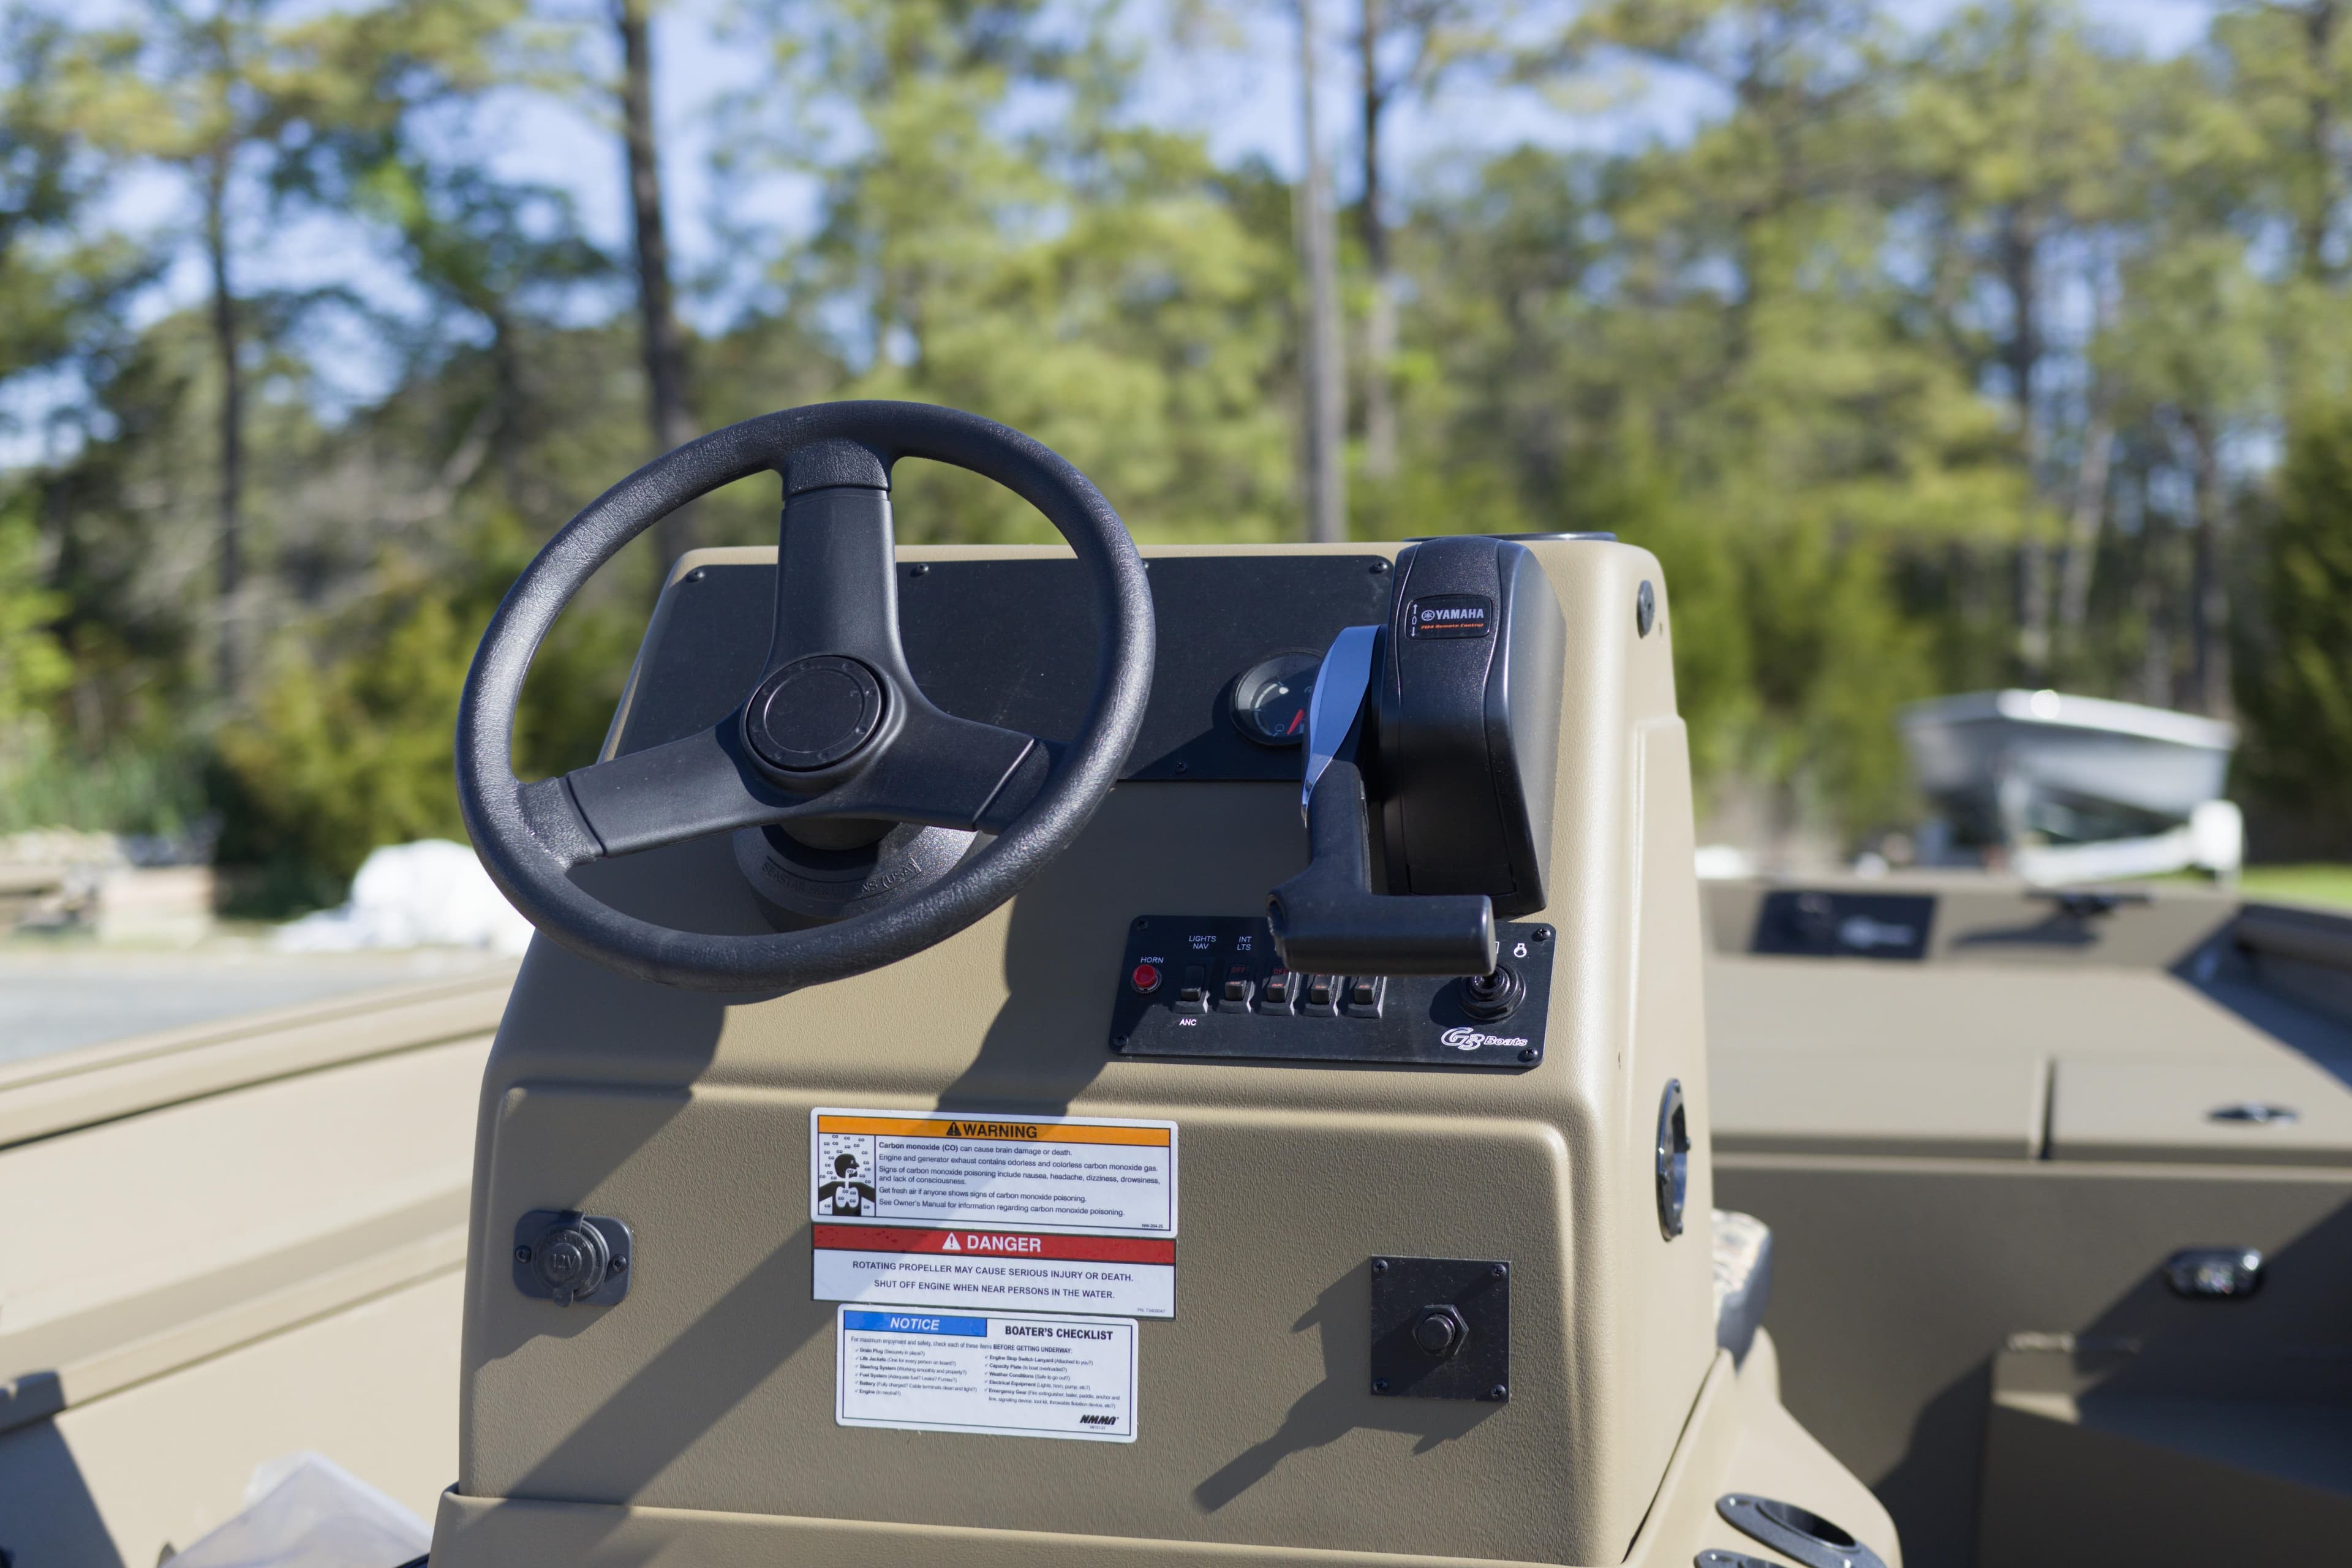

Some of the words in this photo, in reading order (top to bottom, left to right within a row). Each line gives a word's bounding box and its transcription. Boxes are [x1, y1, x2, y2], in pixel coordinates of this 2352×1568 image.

[1436, 609, 1483, 620] YAMAHA
[1484, 1036, 1528, 1046] Boats
[963, 1124, 1038, 1139] WARNING
[941, 1144, 958, 1153] (CO)
[1014, 1147, 1041, 1156] damage
[878, 1153, 902, 1162] Engine
[878, 1165, 897, 1174] Signs
[963, 1169, 996, 1178] poisoning
[1050, 1172, 1084, 1181] headache,
[1085, 1174, 1118, 1183] dizziness,
[1120, 1175, 1160, 1185] drowsiness,
[1053, 1194, 1087, 1204] poisoning.
[997, 1204, 1028, 1213] regarding
[1090, 1208, 1125, 1217] poisoning.
[967, 1235, 1041, 1252] DANGER
[554, 1254, 576, 1268] 12V
[853, 1261, 896, 1270] ROTATING
[899, 1263, 952, 1273] PROPELLER
[975, 1266, 1006, 1275] CAUSE
[1008, 1268, 1048, 1277] SERIOUS
[1050, 1270, 1083, 1279] INJURY
[1101, 1272, 1133, 1281] DEATH.
[874, 1279, 897, 1287] SHUT
[899, 1280, 916, 1289] OFF
[918, 1281, 951, 1291] ENGINE
[953, 1283, 979, 1292] WHEN
[981, 1284, 1005, 1293] NEAR
[1008, 1286, 1049, 1295] PERSONS
[1062, 1288, 1079, 1297] THE
[1082, 1289, 1115, 1298] WATER.
[890, 1317, 940, 1331] NOTICE
[1005, 1325, 1053, 1337] BOATER'S
[1056, 1328, 1113, 1340] CHECKLIST
[1079, 1414, 1117, 1425] NMMA
